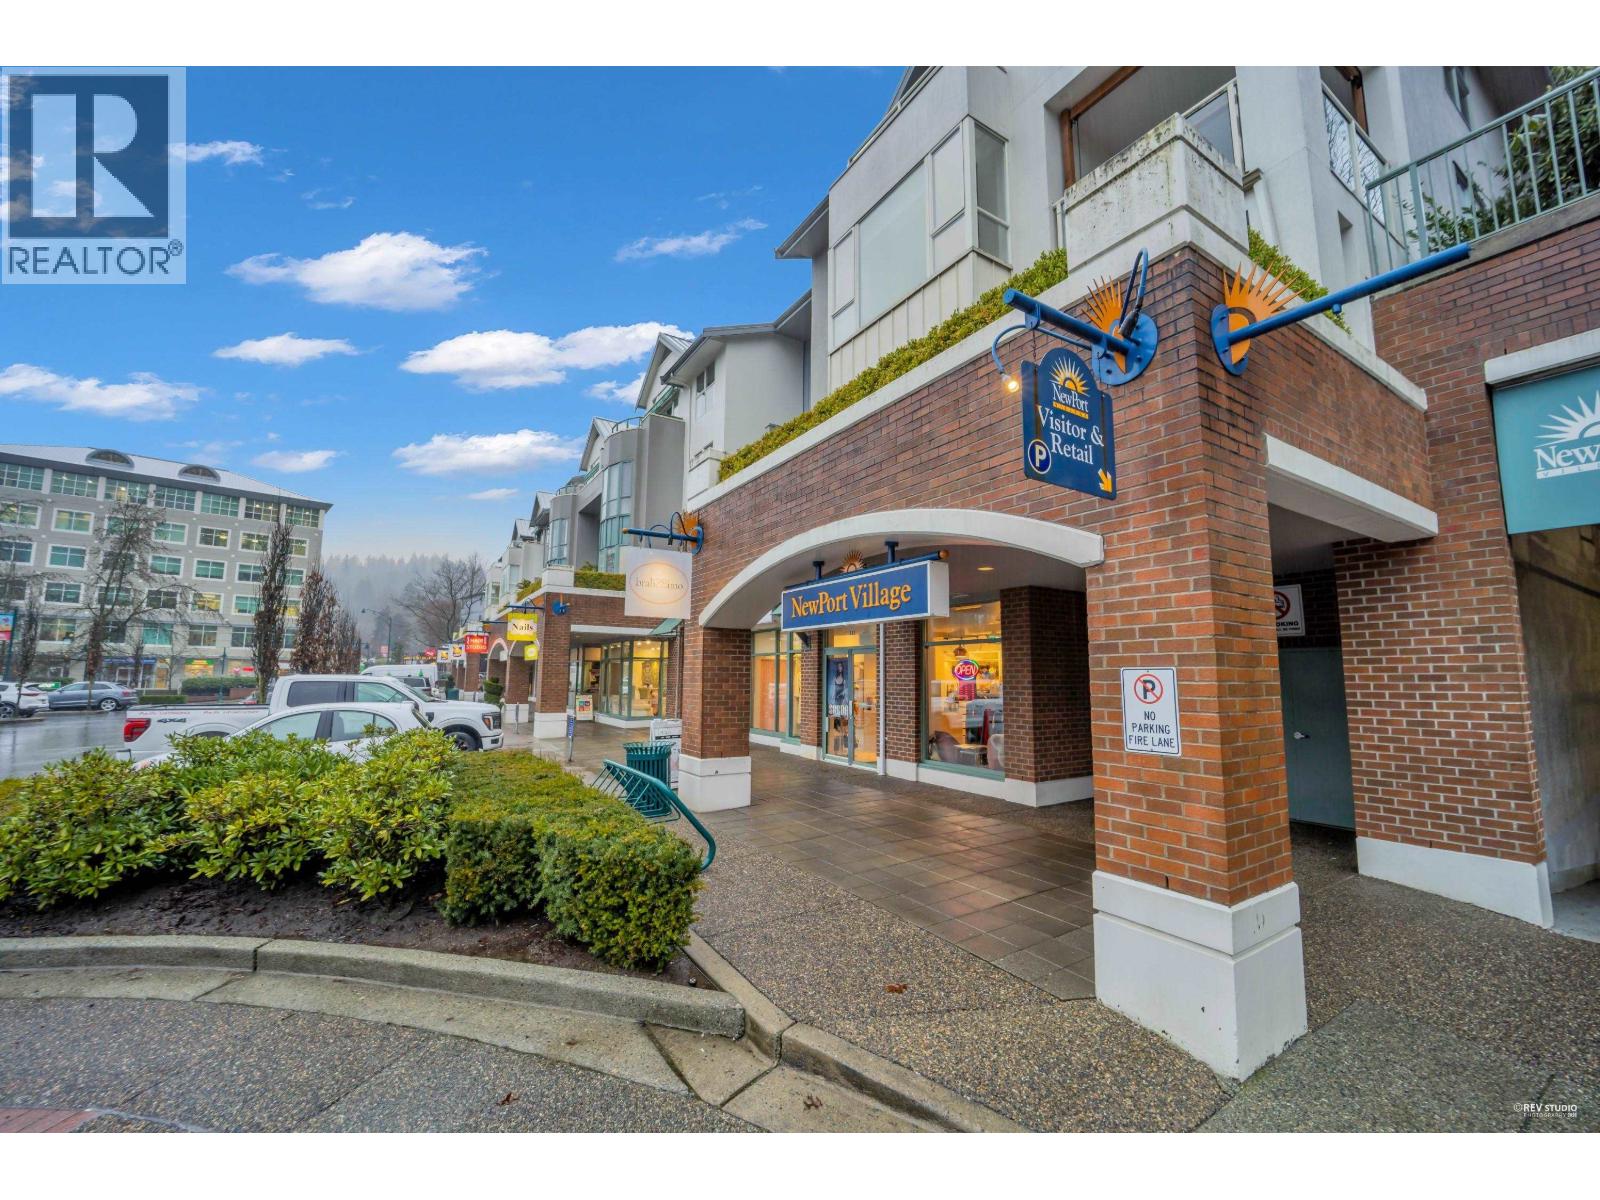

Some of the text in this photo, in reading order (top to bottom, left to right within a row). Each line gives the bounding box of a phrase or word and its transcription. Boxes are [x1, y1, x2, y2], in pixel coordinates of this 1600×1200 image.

[1053, 383, 1089, 413] NewPort
[1038, 405, 1088, 440] Visitor
[1091, 426, 1105, 447] &
[1050, 432, 1094, 465] Retail
[791, 582, 912, 618] NewPort Village
[512, 622, 533, 631] Nails
[957, 664, 976, 676] OPEN
[1144, 711, 1156, 721] NO
[1131, 723, 1171, 735] PARKING
[1128, 735, 1176, 748] FIRE LANE
